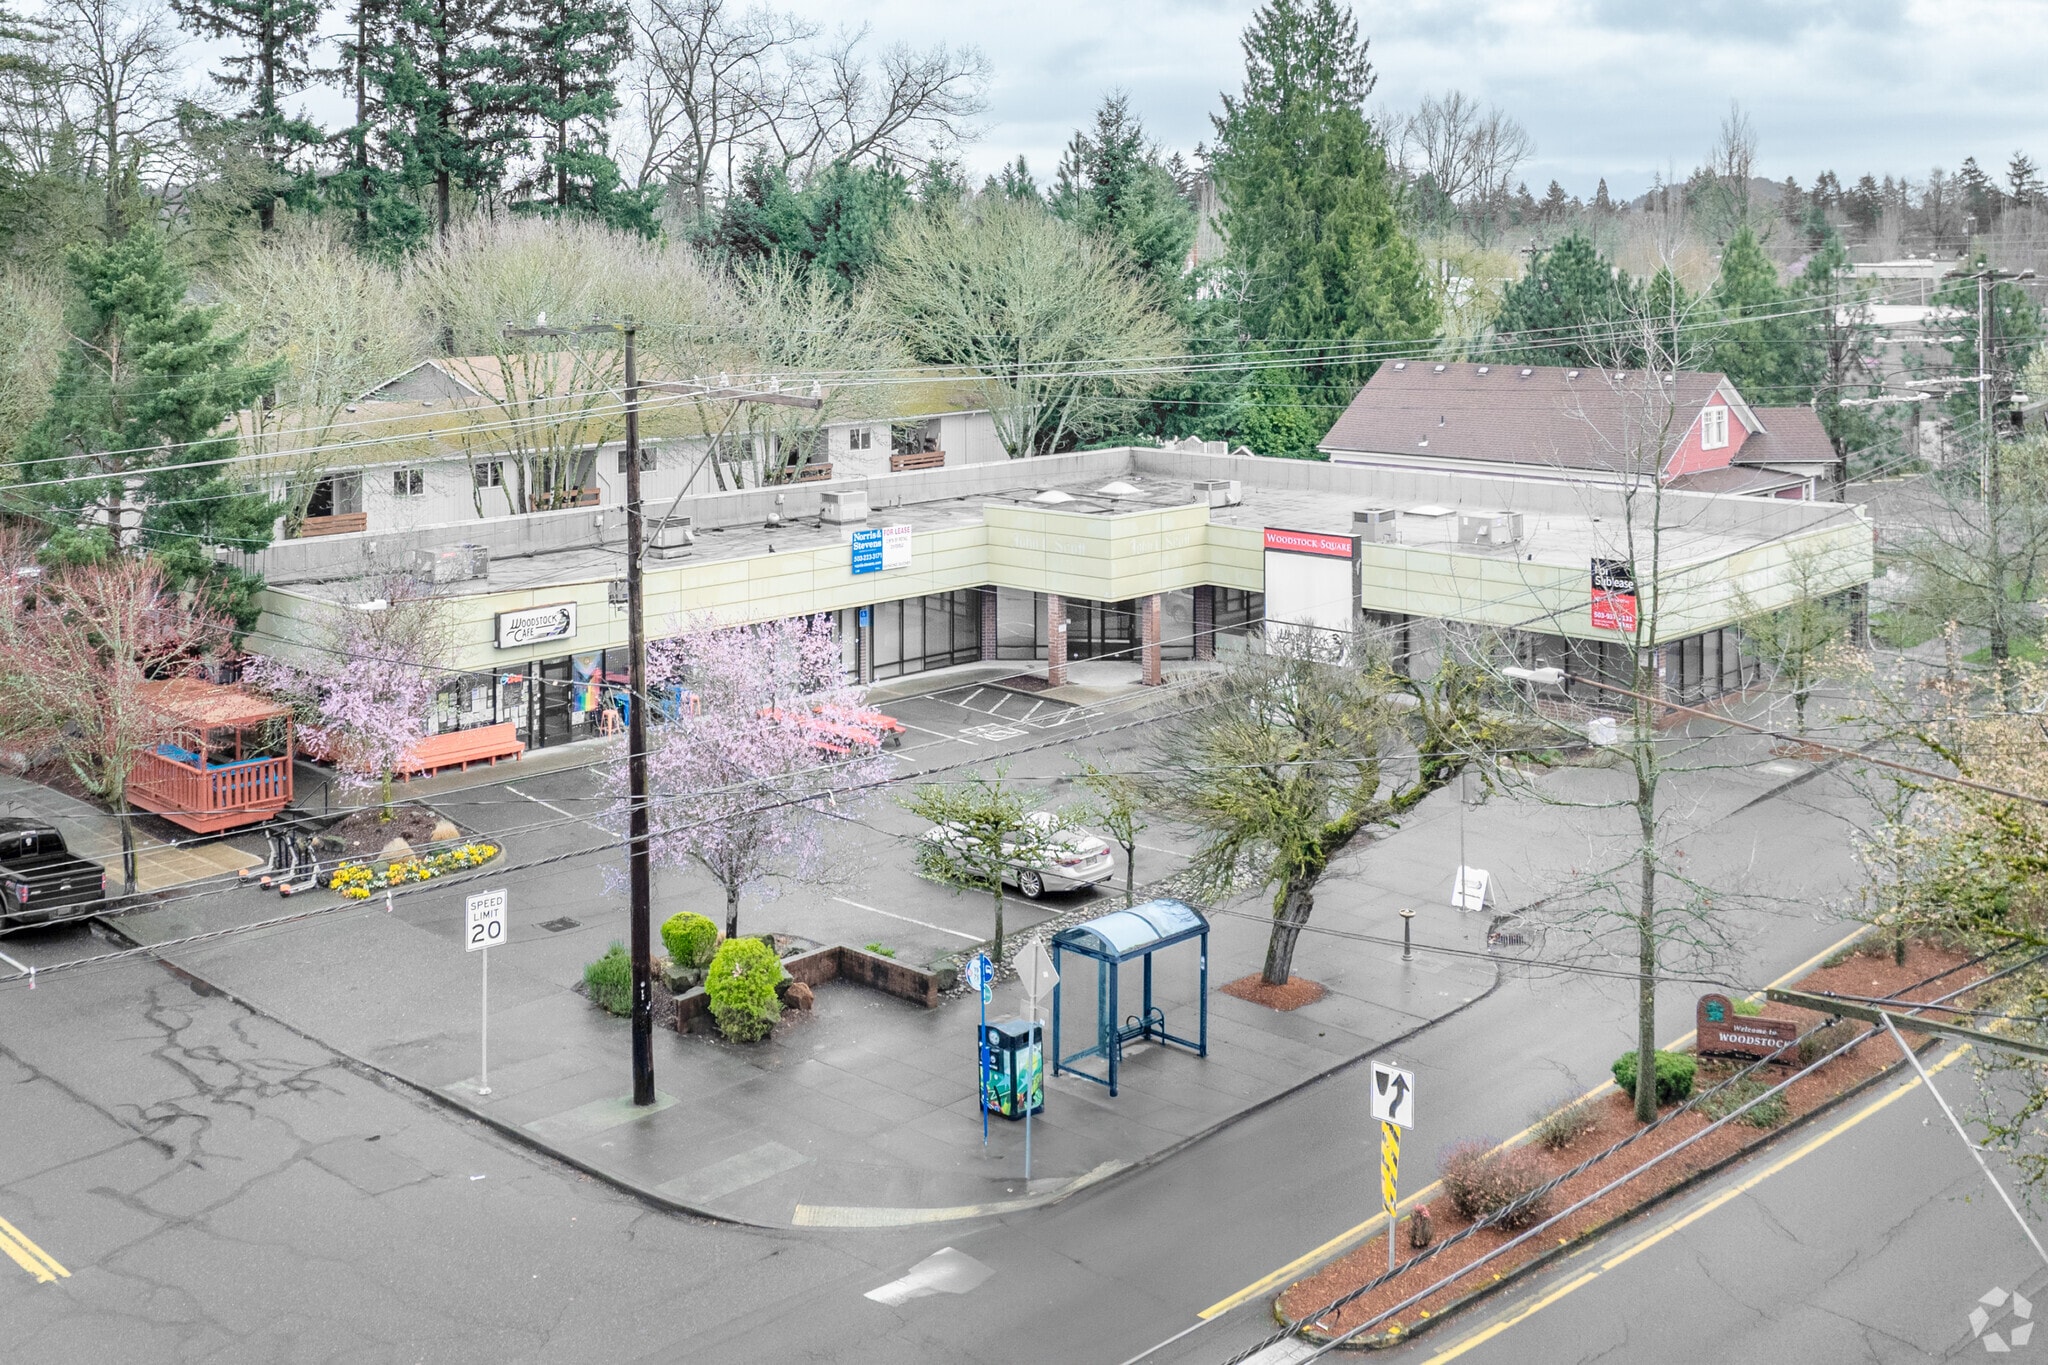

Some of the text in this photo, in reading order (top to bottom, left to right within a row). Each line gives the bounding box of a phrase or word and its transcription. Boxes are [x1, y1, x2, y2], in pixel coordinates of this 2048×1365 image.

[895, 526, 910, 535] LEASE
[854, 541, 882, 551] Stevens
[1266, 533, 1351, 552] WOODSTOCK SQUARE
[510, 615, 558, 630] WOODSTOCK
[471, 897, 503, 911] SPEED
[474, 909, 498, 921] LIMIT
[472, 921, 501, 943] 20
[1733, 1025, 1766, 1035] Welcome
[1719, 1032, 1791, 1048] WOODSTOCK
